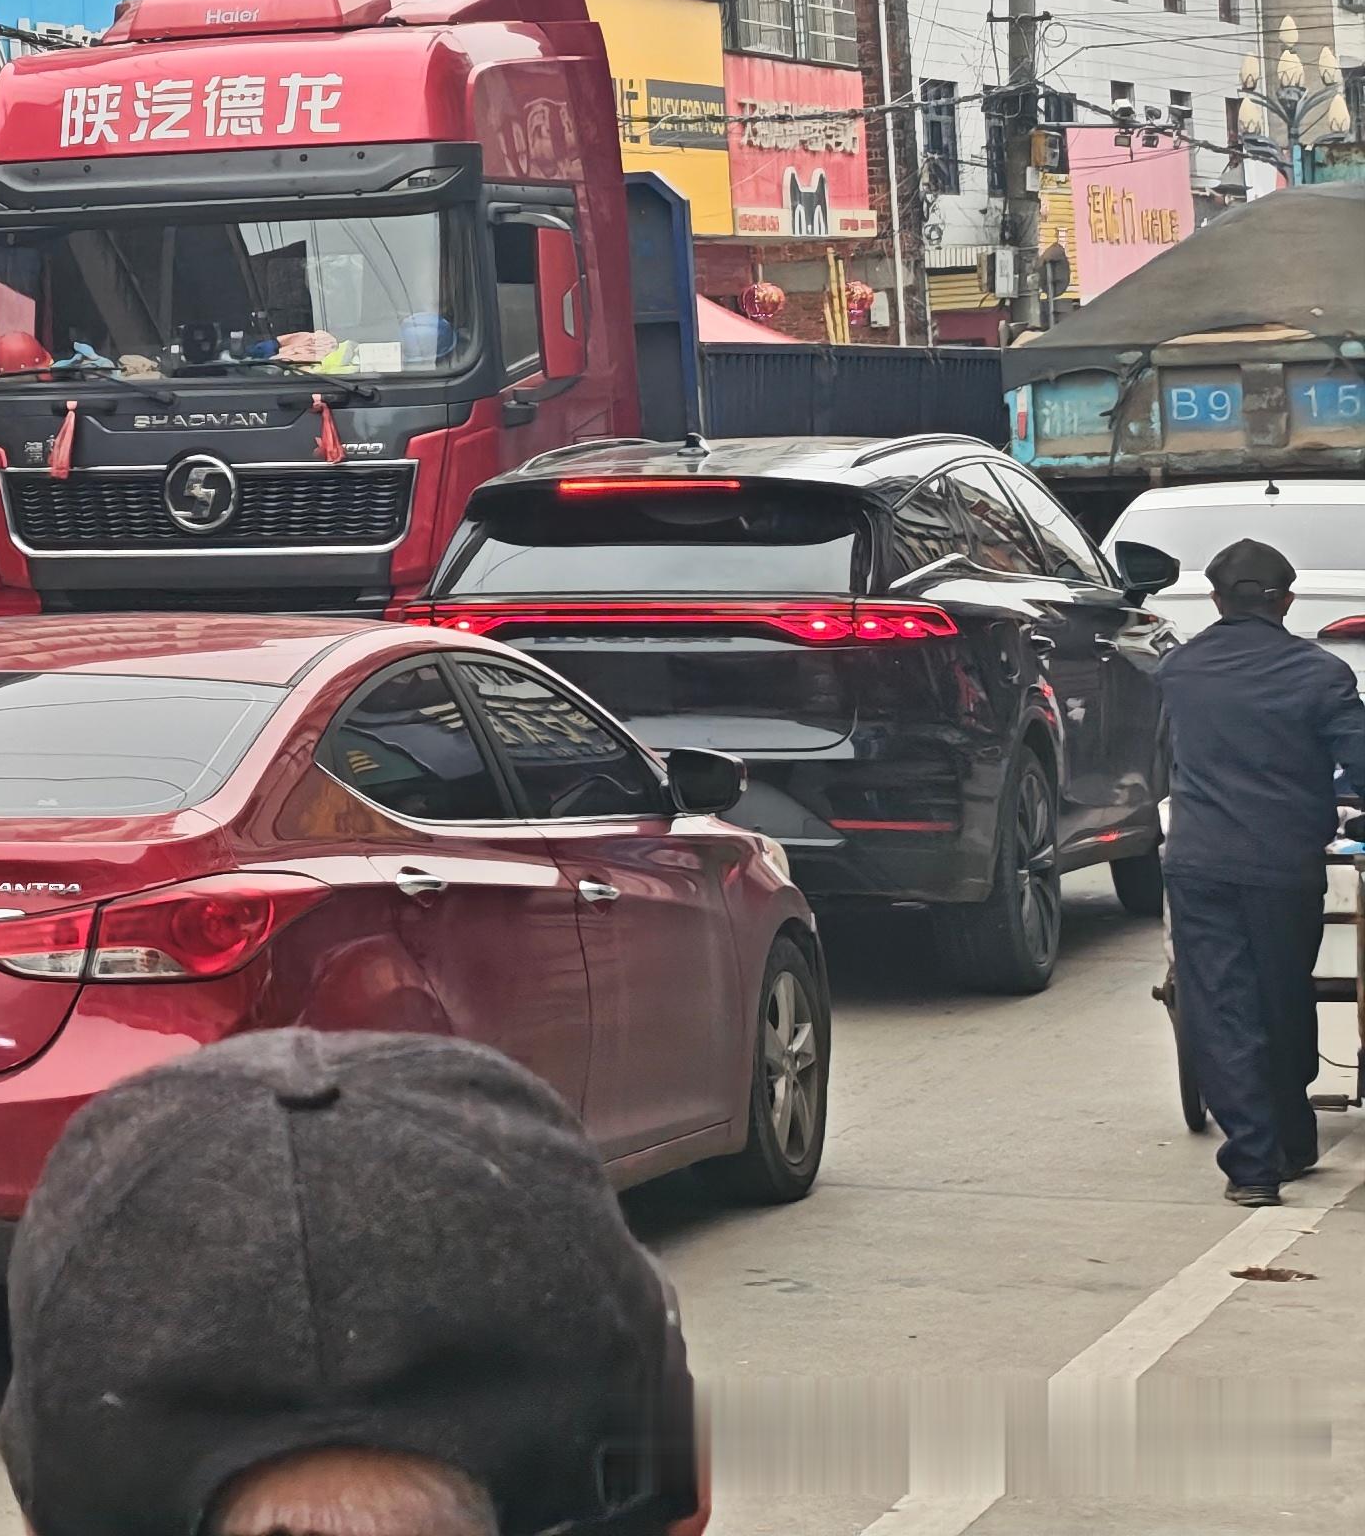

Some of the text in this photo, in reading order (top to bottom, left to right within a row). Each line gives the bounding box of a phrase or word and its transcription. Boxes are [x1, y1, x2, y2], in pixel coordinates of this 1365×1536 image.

[205, 8, 260, 25] Haier
[60, 72, 343, 148] 陕汽德龙
